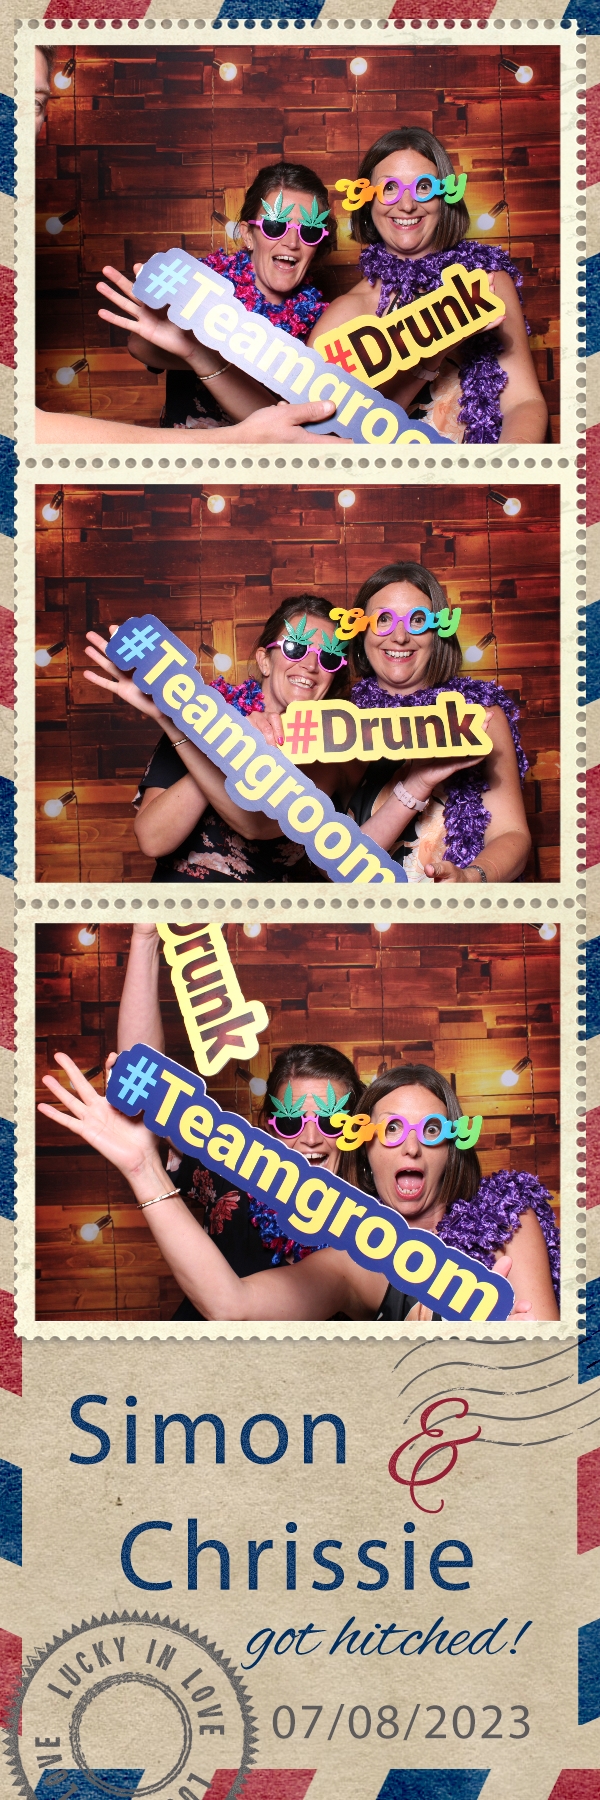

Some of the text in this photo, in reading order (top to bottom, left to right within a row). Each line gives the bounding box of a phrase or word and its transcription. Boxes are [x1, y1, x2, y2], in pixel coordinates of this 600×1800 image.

[324, 273, 495, 378] #Drunk
[116, 624, 395, 883] #Teamgroom
[286, 701, 482, 754] #Drunk
[118, 1056, 499, 1321] #Teamgroom
